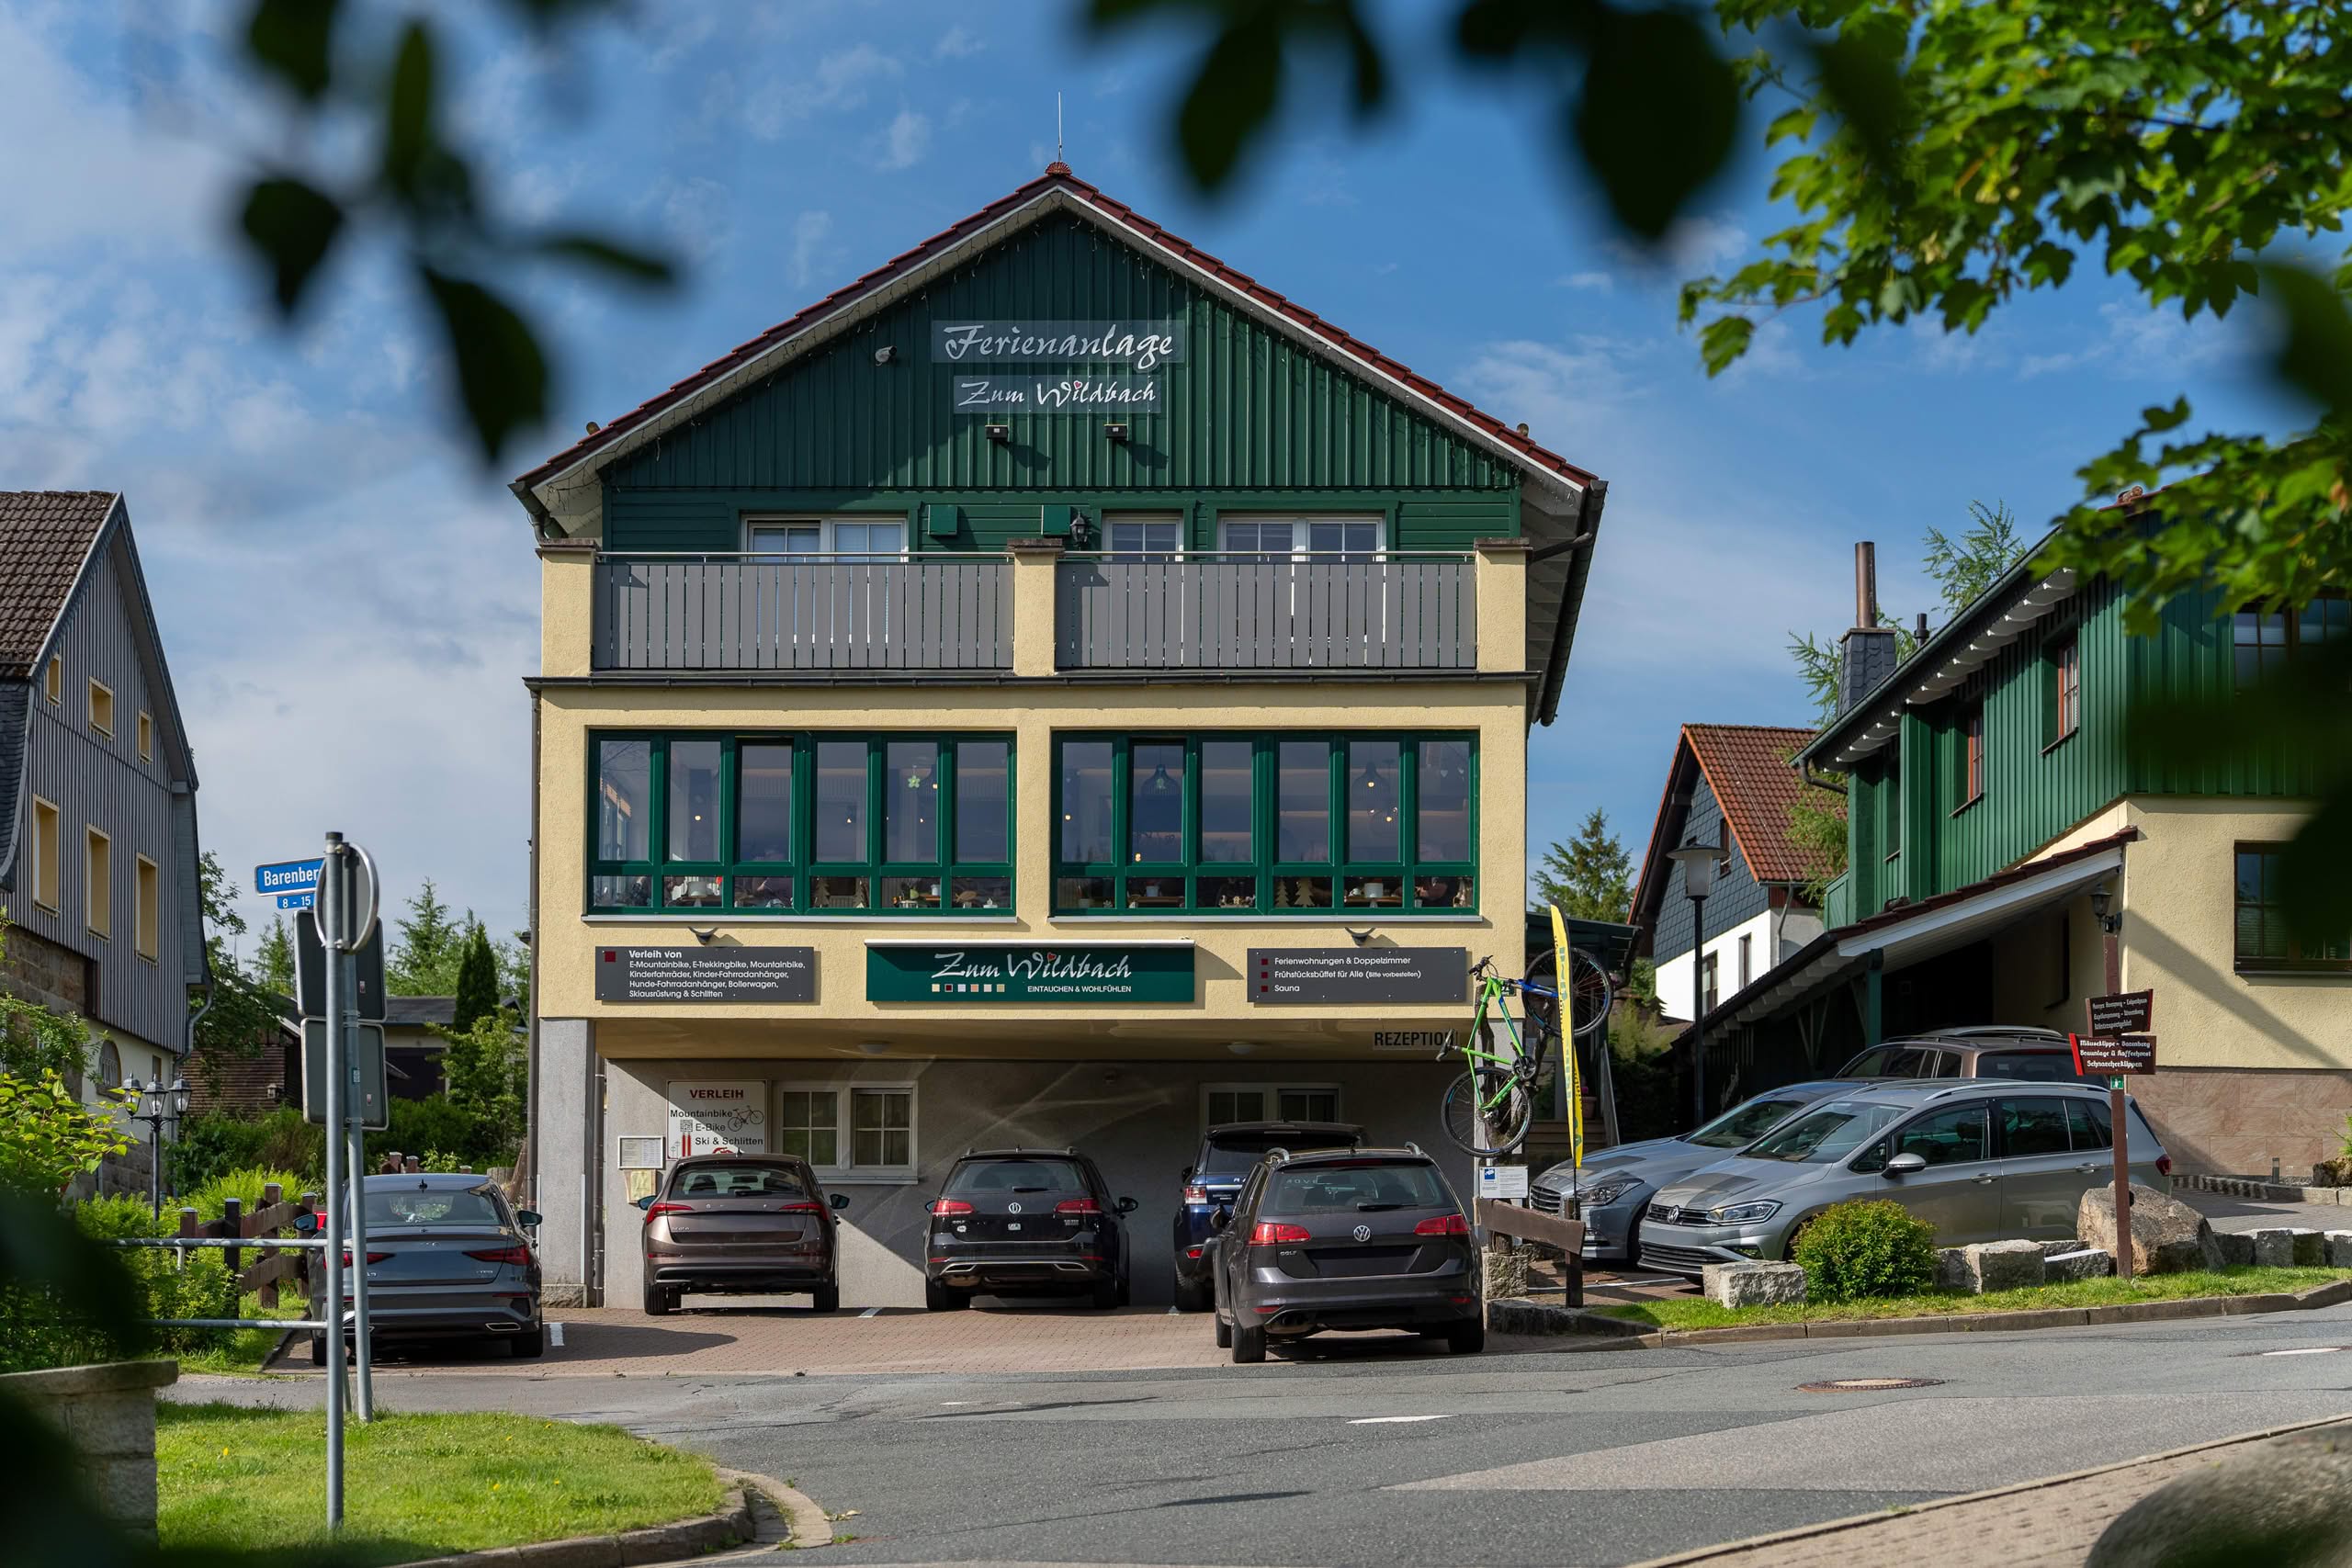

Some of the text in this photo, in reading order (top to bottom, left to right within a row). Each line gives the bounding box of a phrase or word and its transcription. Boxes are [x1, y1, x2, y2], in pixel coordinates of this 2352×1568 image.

[944, 323, 1173, 369] Ferienanlage
[958, 379, 1156, 408] Zum Wildbach
[264, 867, 322, 886] Barenber
[282, 898, 288, 908] 8
[301, 896, 311, 907] 15
[629, 950, 662, 958] Verleih
[693, 961, 748, 969] E-Trekkingbike,
[1275, 957, 1344, 965] Ferienwohnungen
[1354, 957, 1410, 965] Doppelzimmer
[931, 952, 1132, 979] Zum Wildbach
[693, 971, 789, 979] Kinder-Fahrradanhänger,
[729, 981, 778, 989] Bollerwagen,
[629, 990, 681, 998] Skiausrüstung
[2087, 1060, 2143, 1068] Schnarcherklippen
[690, 1089, 744, 1099] VERLEIH
[670, 1110, 732, 1118] Mountainbike
[696, 1123, 726, 1132] E-Bike
[695, 1137, 709, 1145] Ski
[722, 1137, 763, 1145] Schlitten
